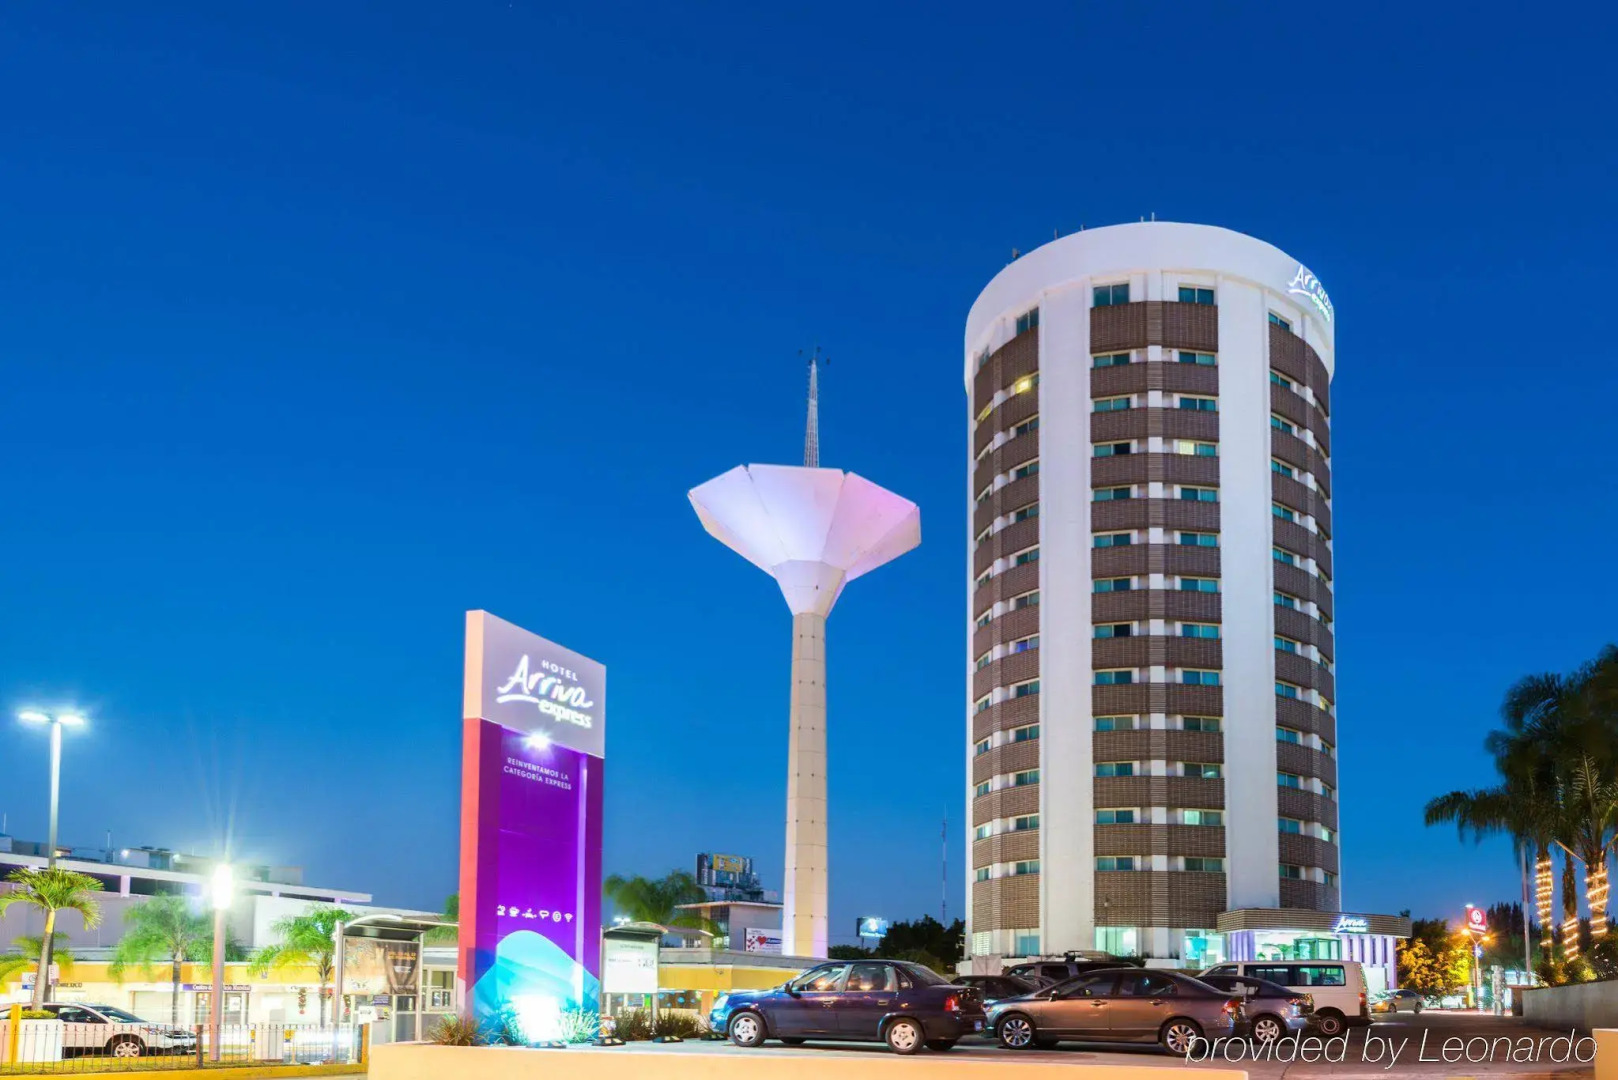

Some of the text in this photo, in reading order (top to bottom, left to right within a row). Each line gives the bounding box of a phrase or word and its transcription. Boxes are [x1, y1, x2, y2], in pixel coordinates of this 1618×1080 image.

[497, 654, 594, 708] Arriva
[541, 659, 578, 681] HOTEL
[538, 699, 592, 729] express
[503, 765, 572, 790] CATEGORÍA EXPRESS
[507, 757, 559, 778] REINVENTAMOS
